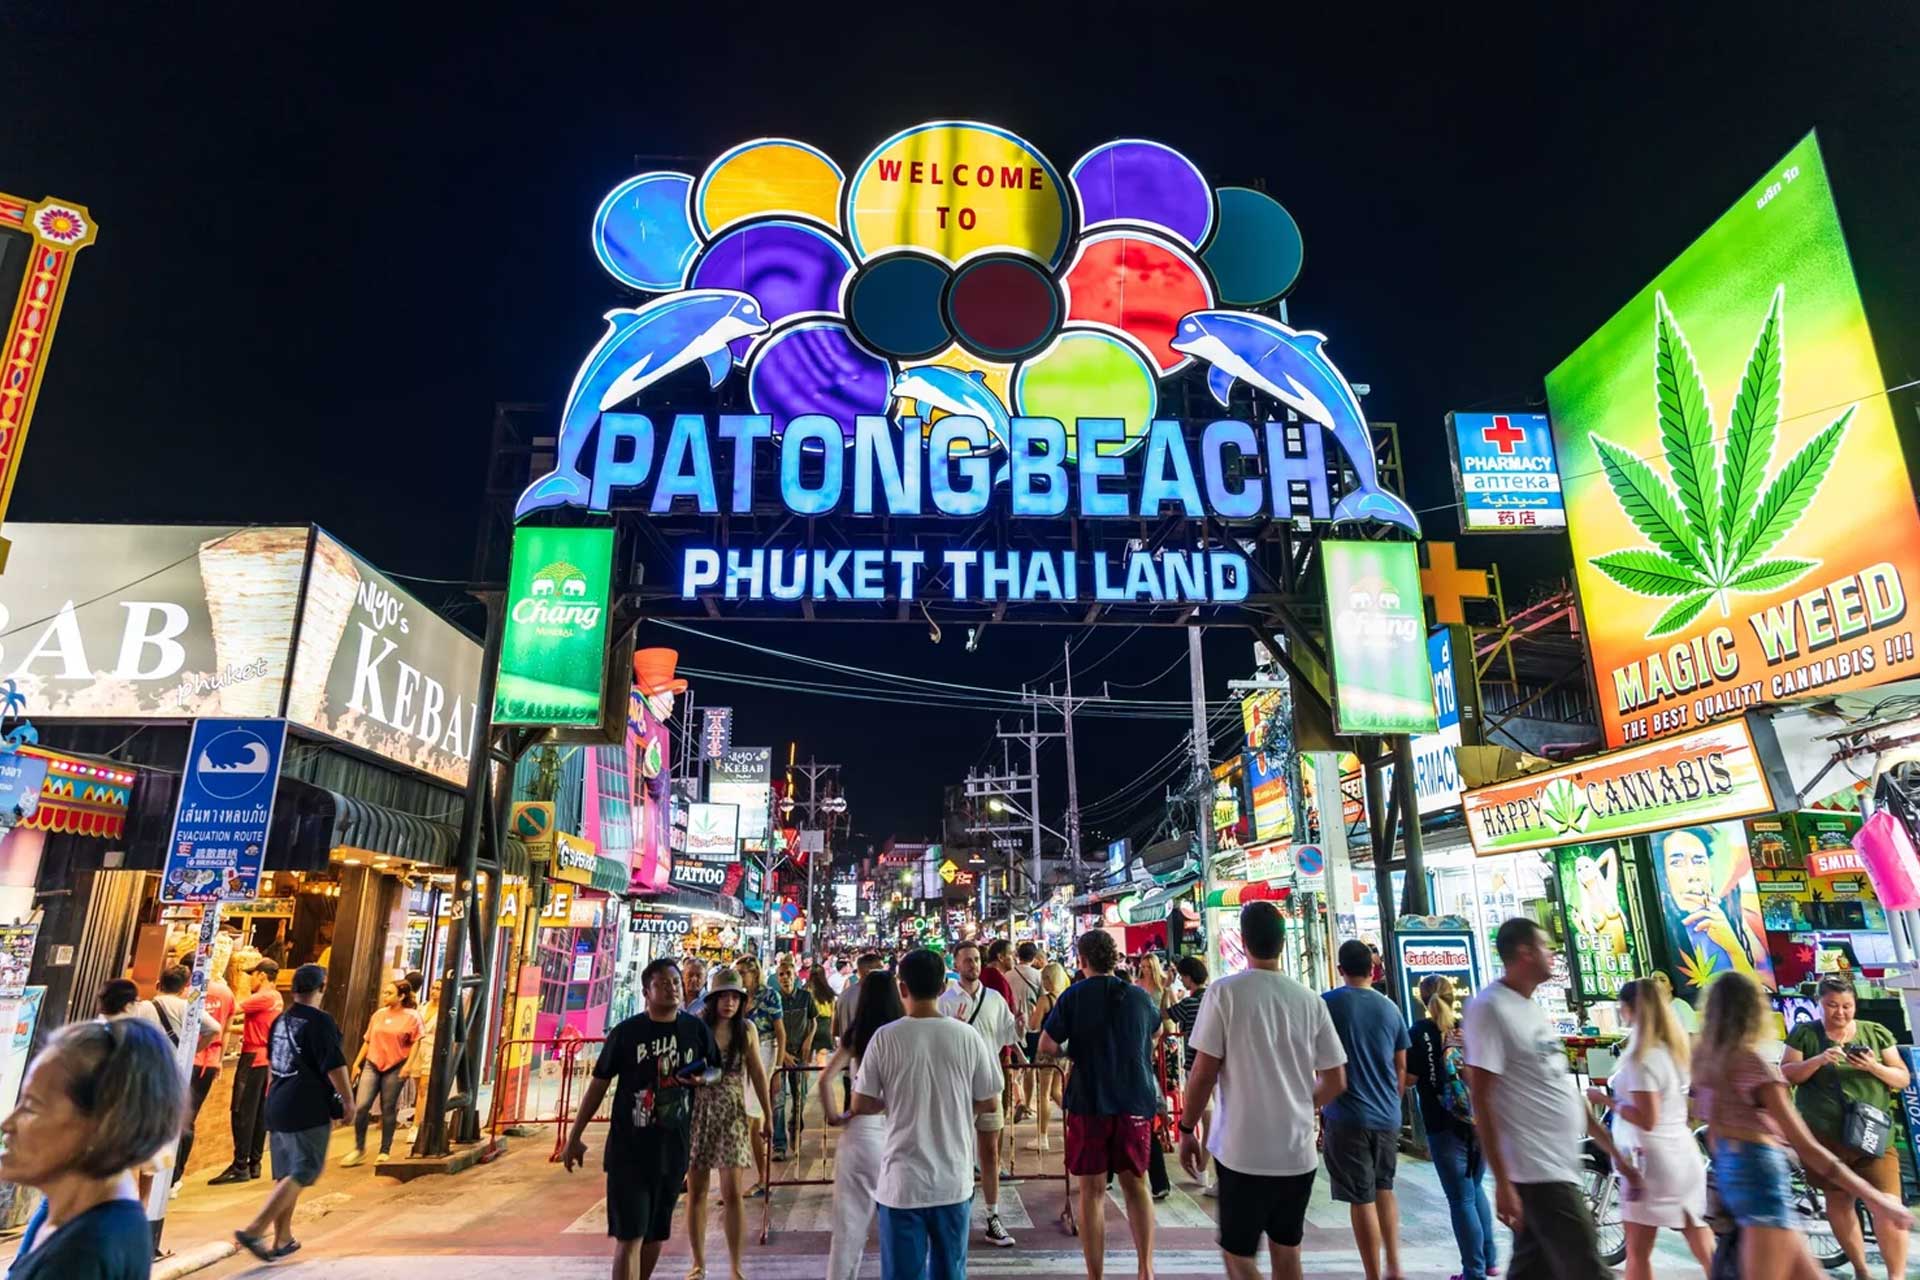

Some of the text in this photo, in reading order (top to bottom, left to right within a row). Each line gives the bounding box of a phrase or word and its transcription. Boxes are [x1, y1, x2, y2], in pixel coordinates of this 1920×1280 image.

[878, 159, 1044, 191] WELCOME
[936, 206, 977, 231] TO
[590, 411, 1331, 520] PATONG BEACH
[1464, 456, 1551, 472] PHARMACY
[1474, 476, 1550, 489] аптека
[1497, 510, 1536, 526] 药店
[683, 547, 925, 600] PHUKET
[511, 598, 601, 630] Chang
[0, 600, 190, 681] AB
[1612, 562, 1906, 716] MAGIC WEED
[176, 656, 268, 705] phuket
[1622, 717, 1648, 742] THE
[1653, 704, 1688, 734] BEST
[1695, 681, 1763, 720] QUALITY
[1772, 646, 1875, 699] CANNABIS
[724, 762, 764, 773] KEBAB
[1481, 752, 1734, 838] HAPPY CANNABIS
[180, 802, 267, 824] เส้นทางหลบภัย
[176, 830, 263, 841] EVACUATION ROUTE
[674, 865, 725, 884] TATTOO
[631, 918, 689, 934] TATTOO
[1576, 934, 1612, 951] GET
[1405, 951, 1468, 966] Guideline
[1578, 953, 1632, 973] HIGH
[1904, 1085, 1920, 1127] ZONE
